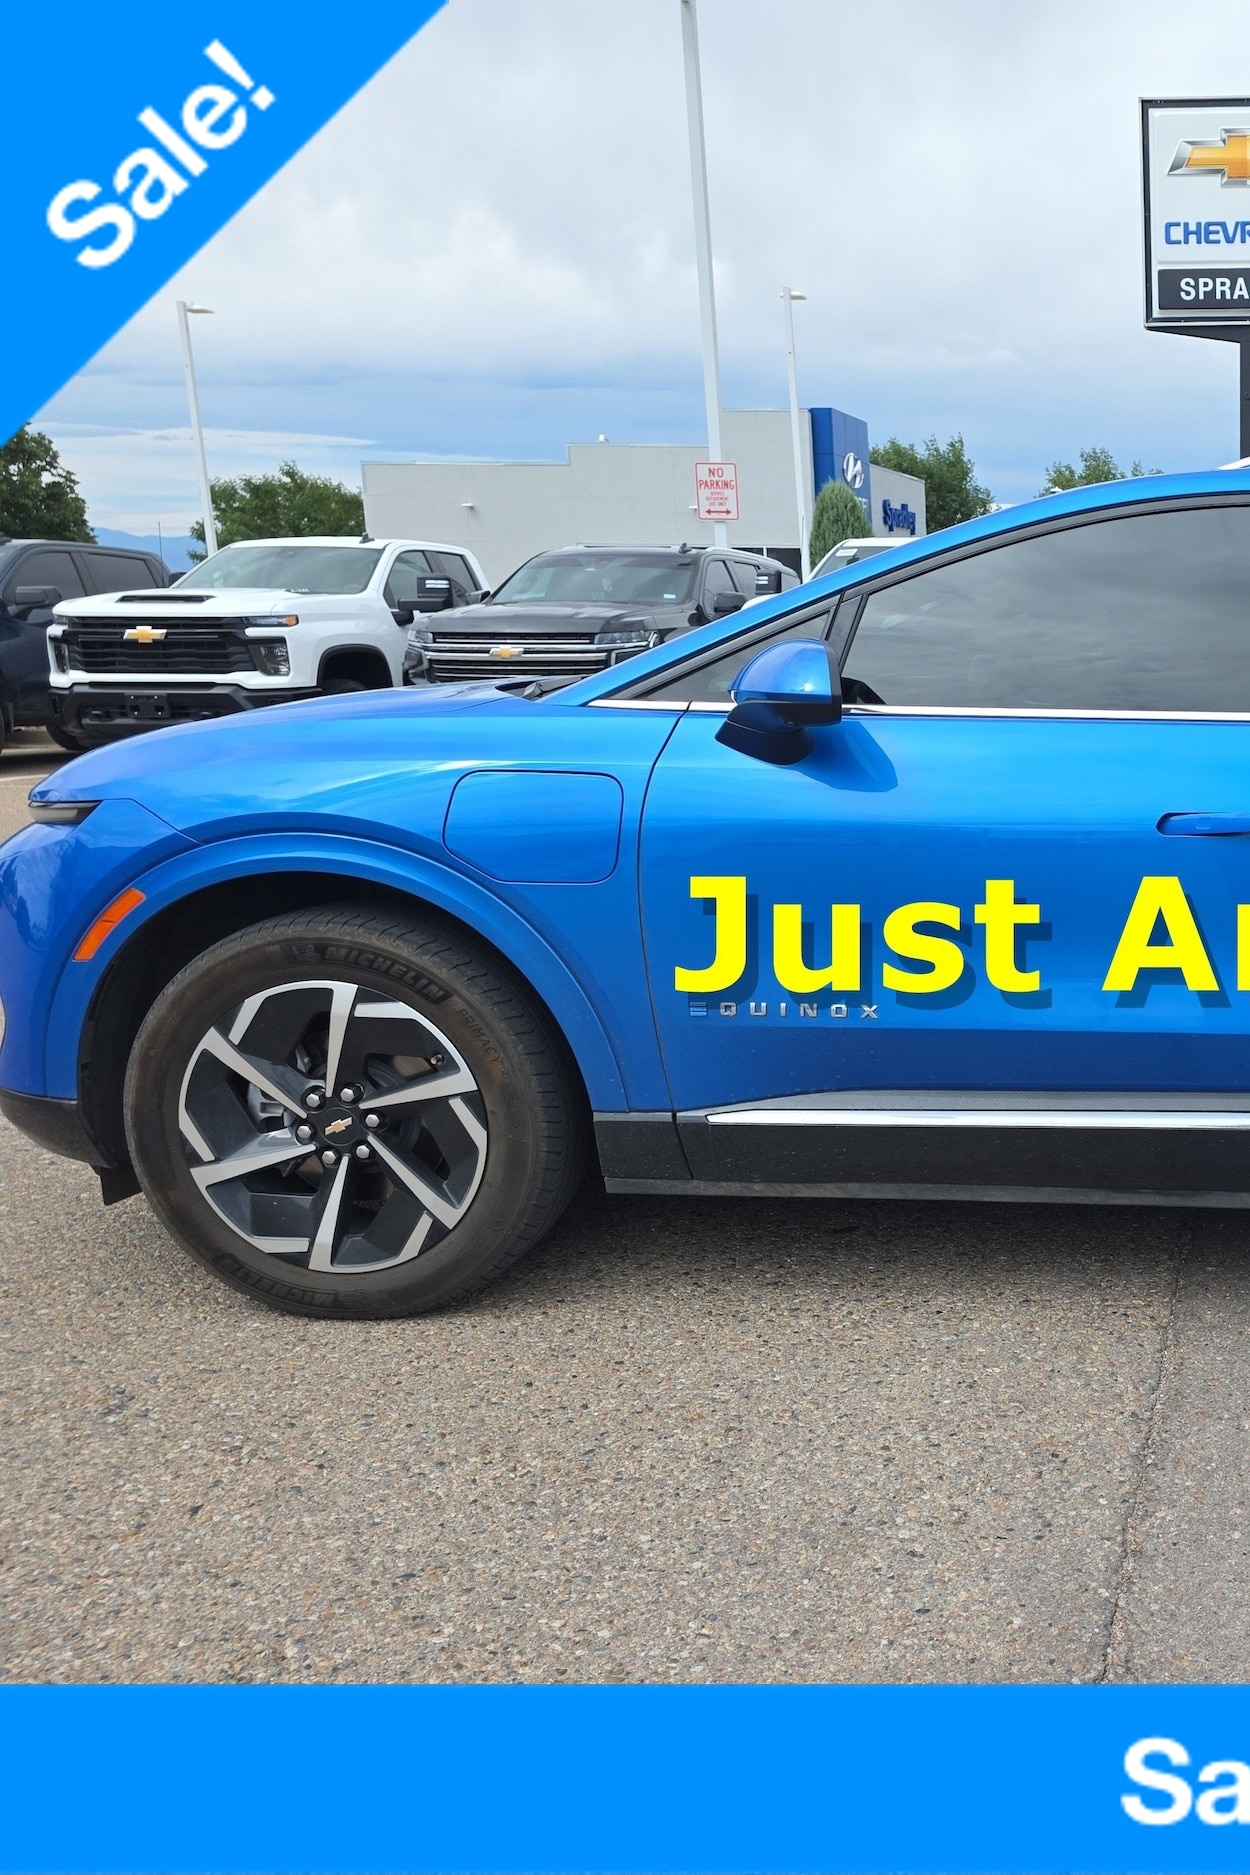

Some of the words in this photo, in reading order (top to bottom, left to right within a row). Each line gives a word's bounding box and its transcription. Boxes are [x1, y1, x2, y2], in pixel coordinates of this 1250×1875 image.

[699, 479, 735, 490] PARKING
[708, 467, 724, 478] NO
[883, 499, 916, 535] Spradley
[325, 946, 445, 1000] MICHELIN
[690, 1002, 879, 1018] EQUINOX
[456, 1007, 502, 1064] PRIMACY
[216, 1257, 337, 1308] MICHELIN
